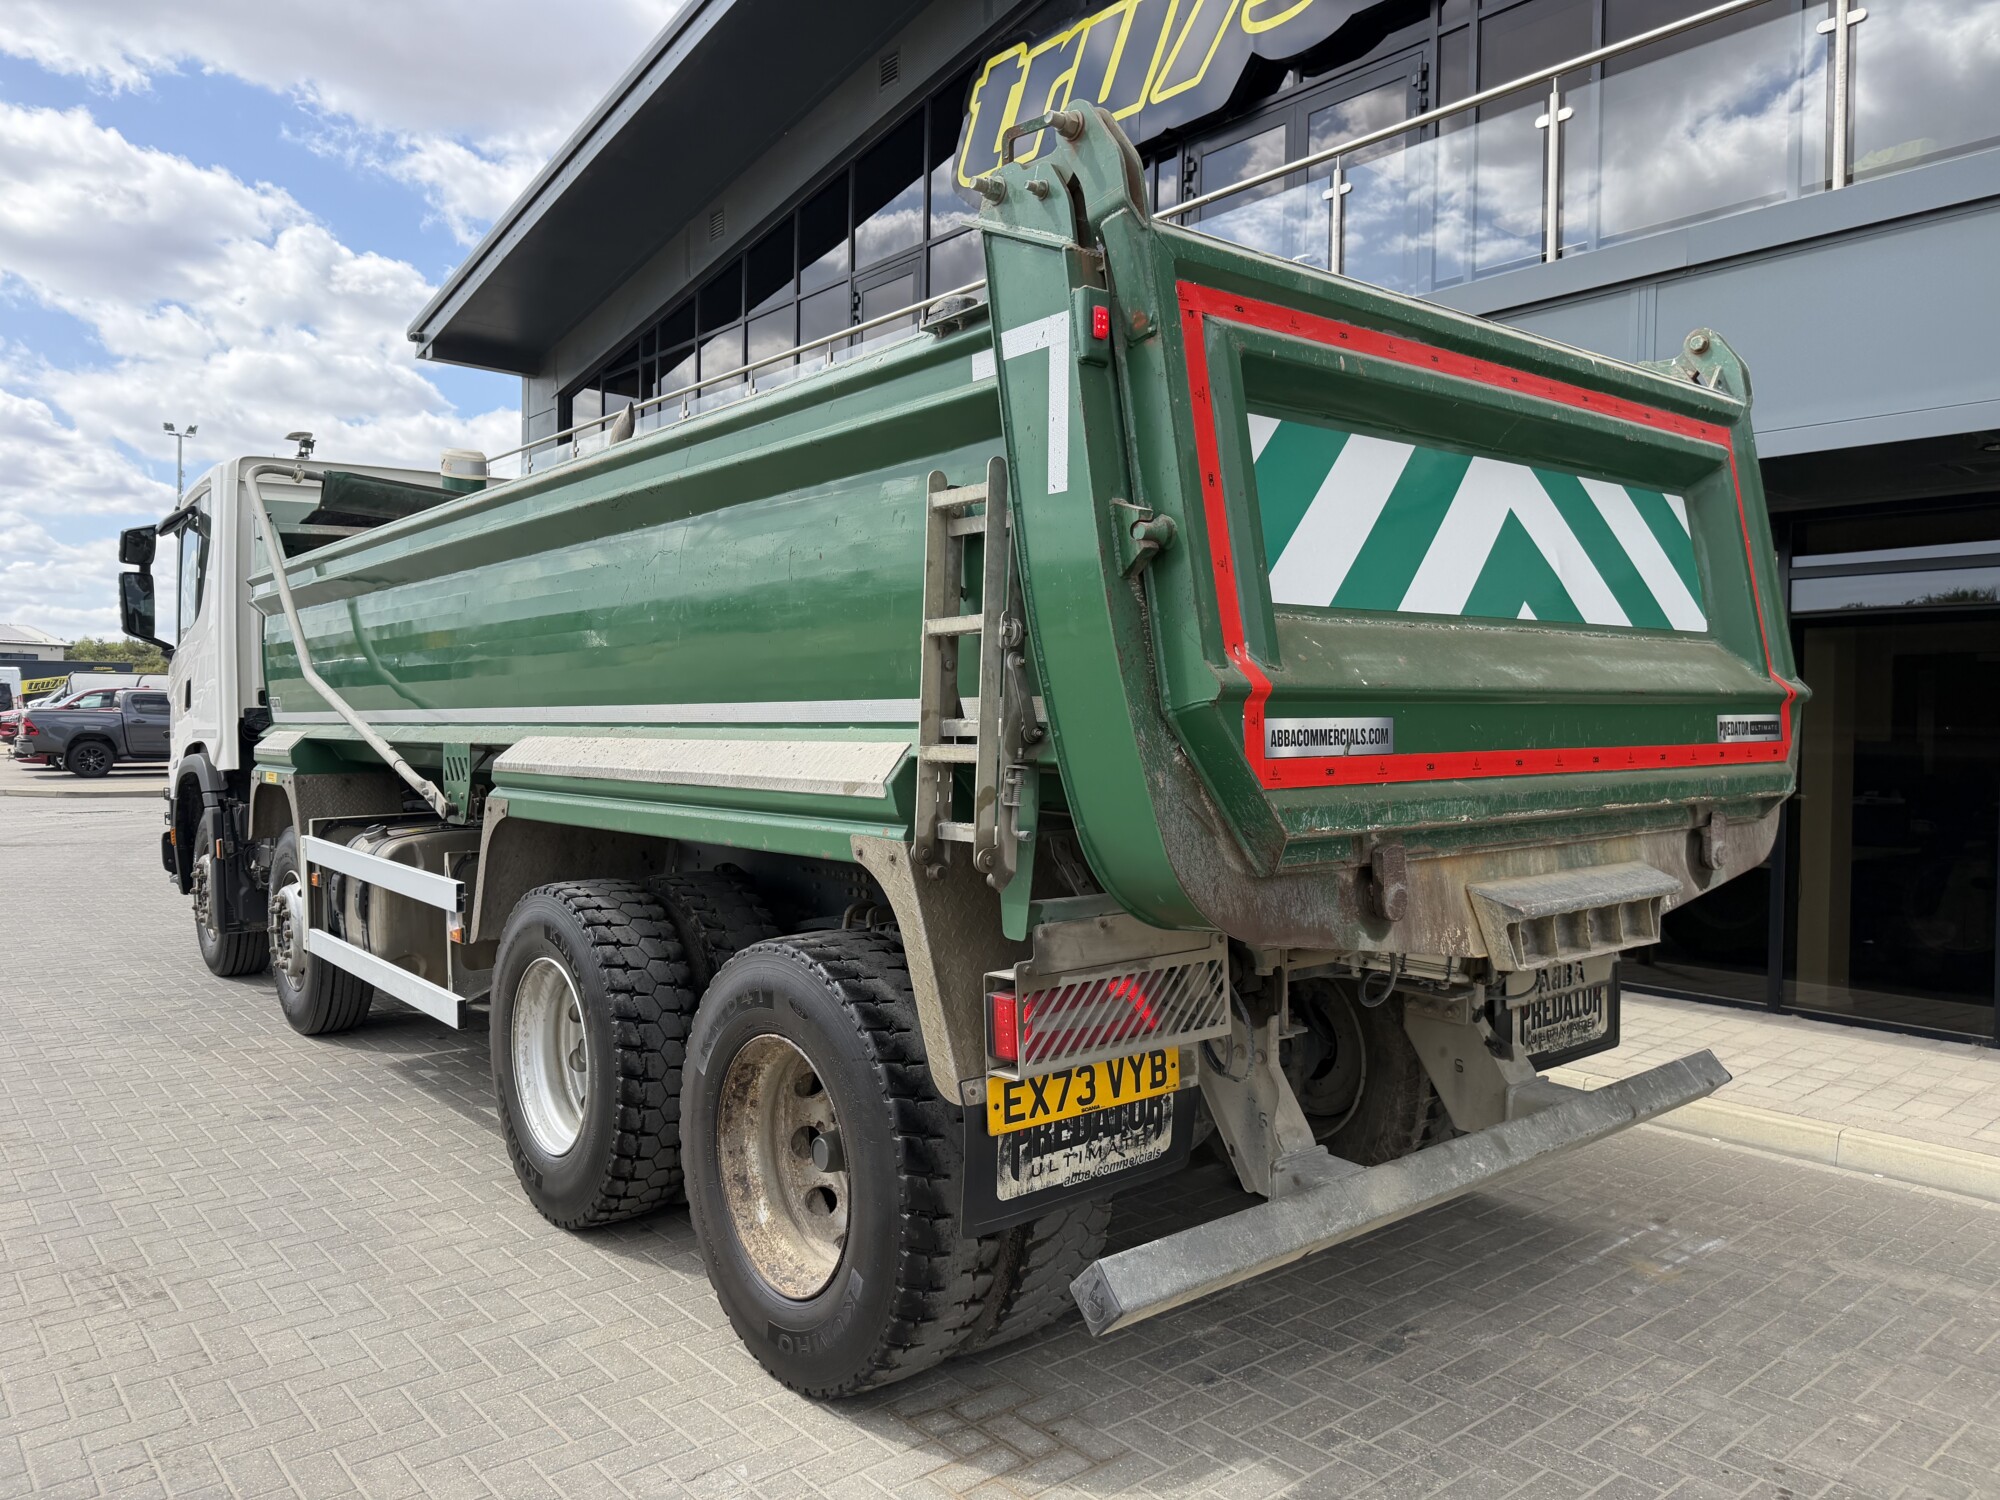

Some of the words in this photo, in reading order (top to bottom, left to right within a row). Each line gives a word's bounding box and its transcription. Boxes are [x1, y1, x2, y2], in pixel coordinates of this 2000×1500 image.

[1270, 727, 1389, 748] ABBACOMMERCIALS.COM
[1719, 721, 1749, 740] PREDATOR
[1003, 1064, 1096, 1124] EX73
[1106, 1049, 1168, 1099] VYB
[1081, 1105, 1100, 1113] SCANIA
[1031, 1134, 1147, 1178] ULTIMATE
